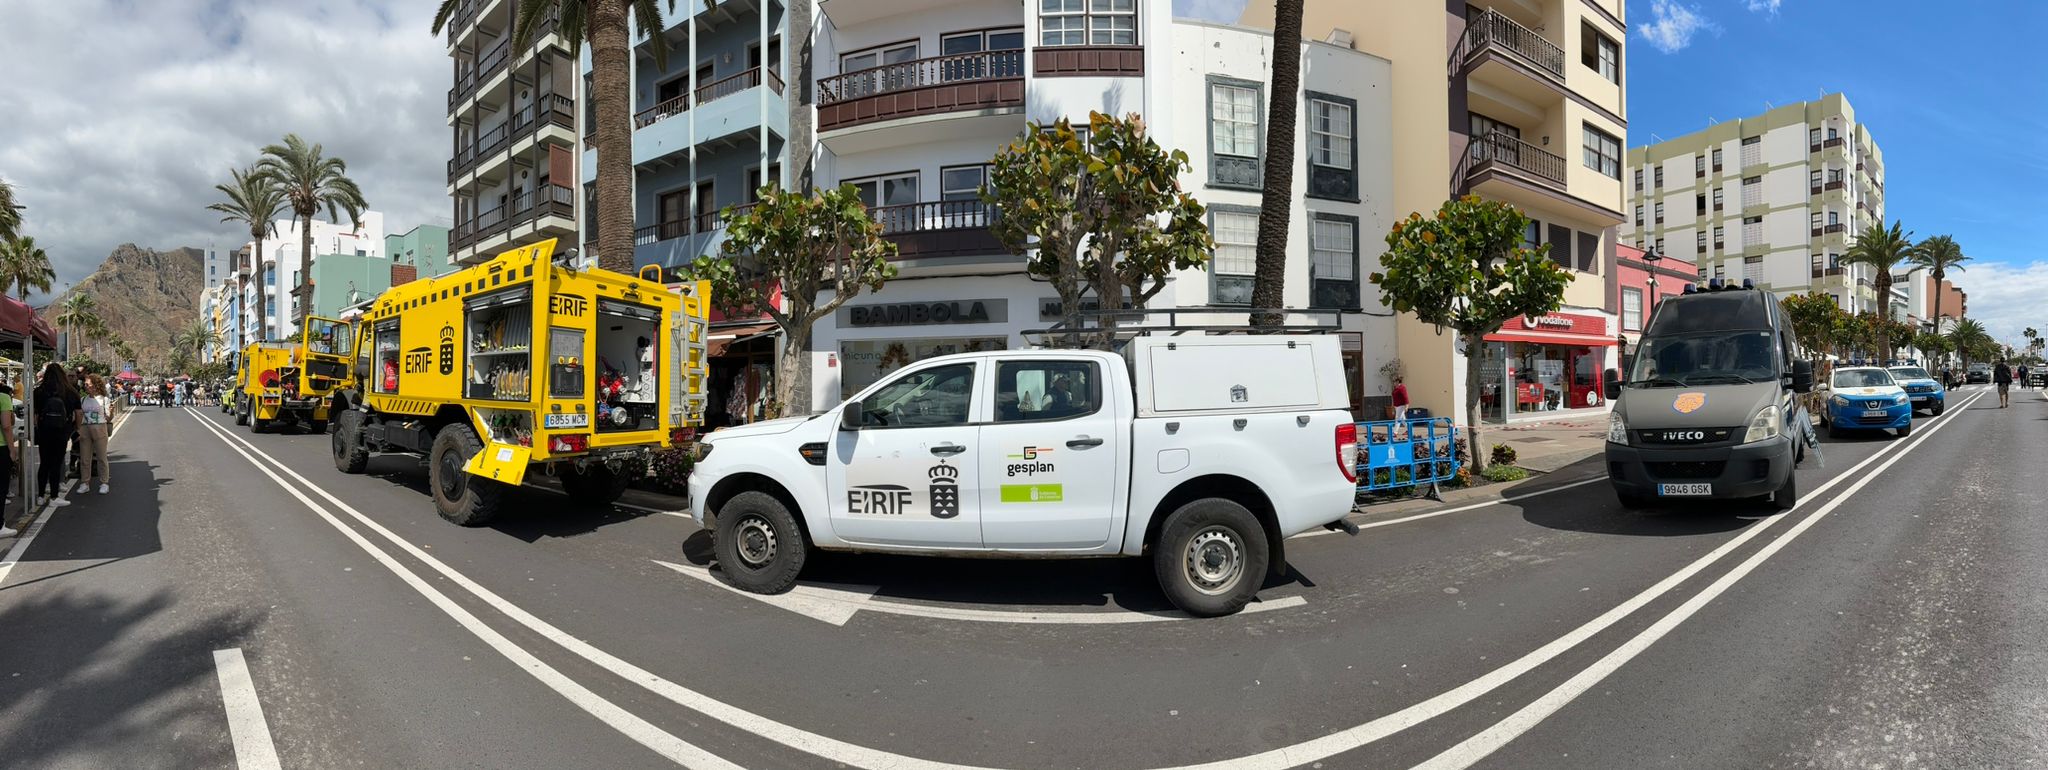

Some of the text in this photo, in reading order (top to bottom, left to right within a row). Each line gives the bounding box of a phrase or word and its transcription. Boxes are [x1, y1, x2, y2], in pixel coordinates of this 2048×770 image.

[549, 295, 588, 318] EIRIF
[851, 302, 989, 325] BAMBOLA
[1540, 315, 1573, 326] vodafone
[405, 352, 432, 374] EIRIF
[572, 414, 586, 424] MCR
[1007, 461, 1054, 477] gesplan
[1664, 485, 1710, 494] 9946 GSK
[848, 491, 912, 515] EIRIF
